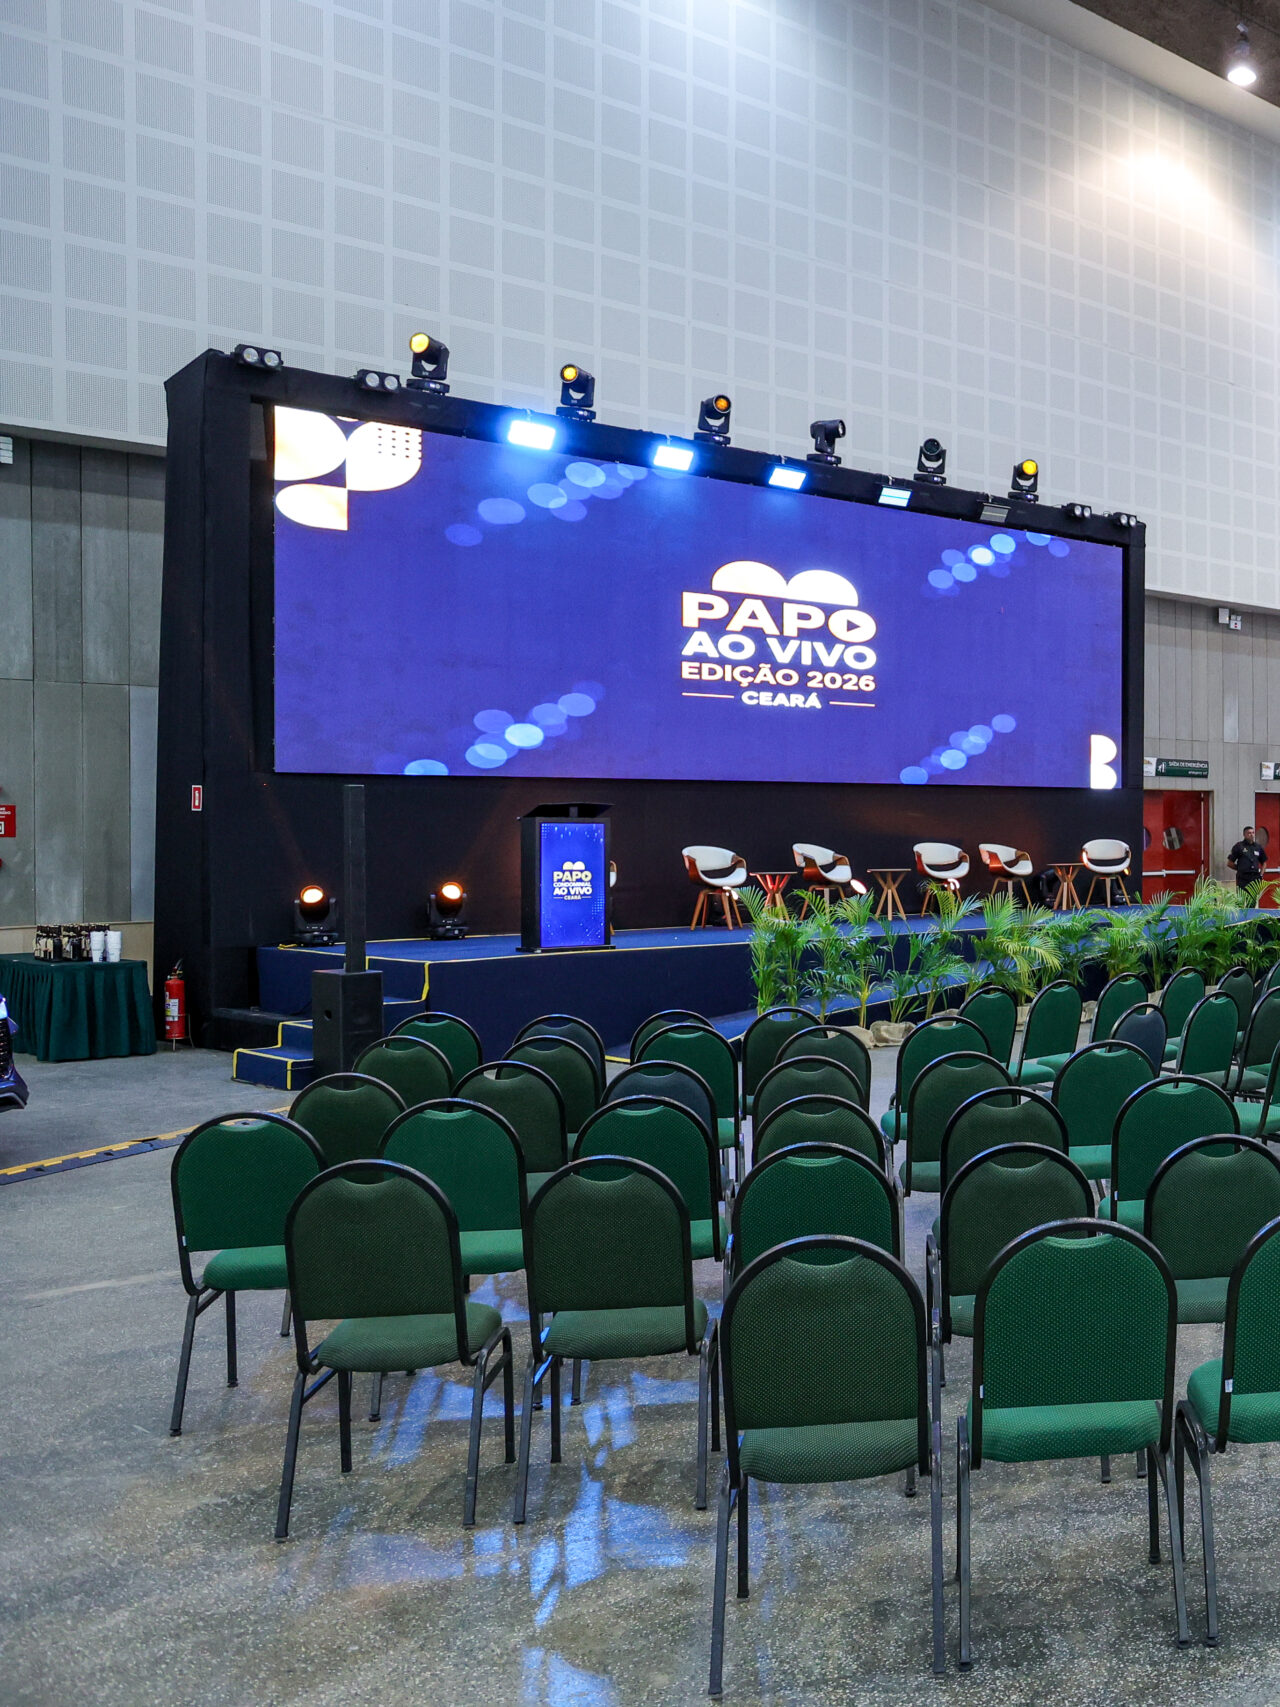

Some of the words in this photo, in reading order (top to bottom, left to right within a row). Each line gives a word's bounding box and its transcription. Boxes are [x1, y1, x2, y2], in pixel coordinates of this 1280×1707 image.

[682, 591, 877, 643] PAPO
[681, 631, 756, 660] AO
[766, 637, 877, 670] VIVO
[681, 661, 799, 687] EDIÇÃO
[806, 671, 876, 692] 2026
[741, 691, 822, 709] CEARÁ
[553, 871, 592, 882] PAPO
[553, 887, 568, 895] AO
[569, 887, 592, 895] VIVO
